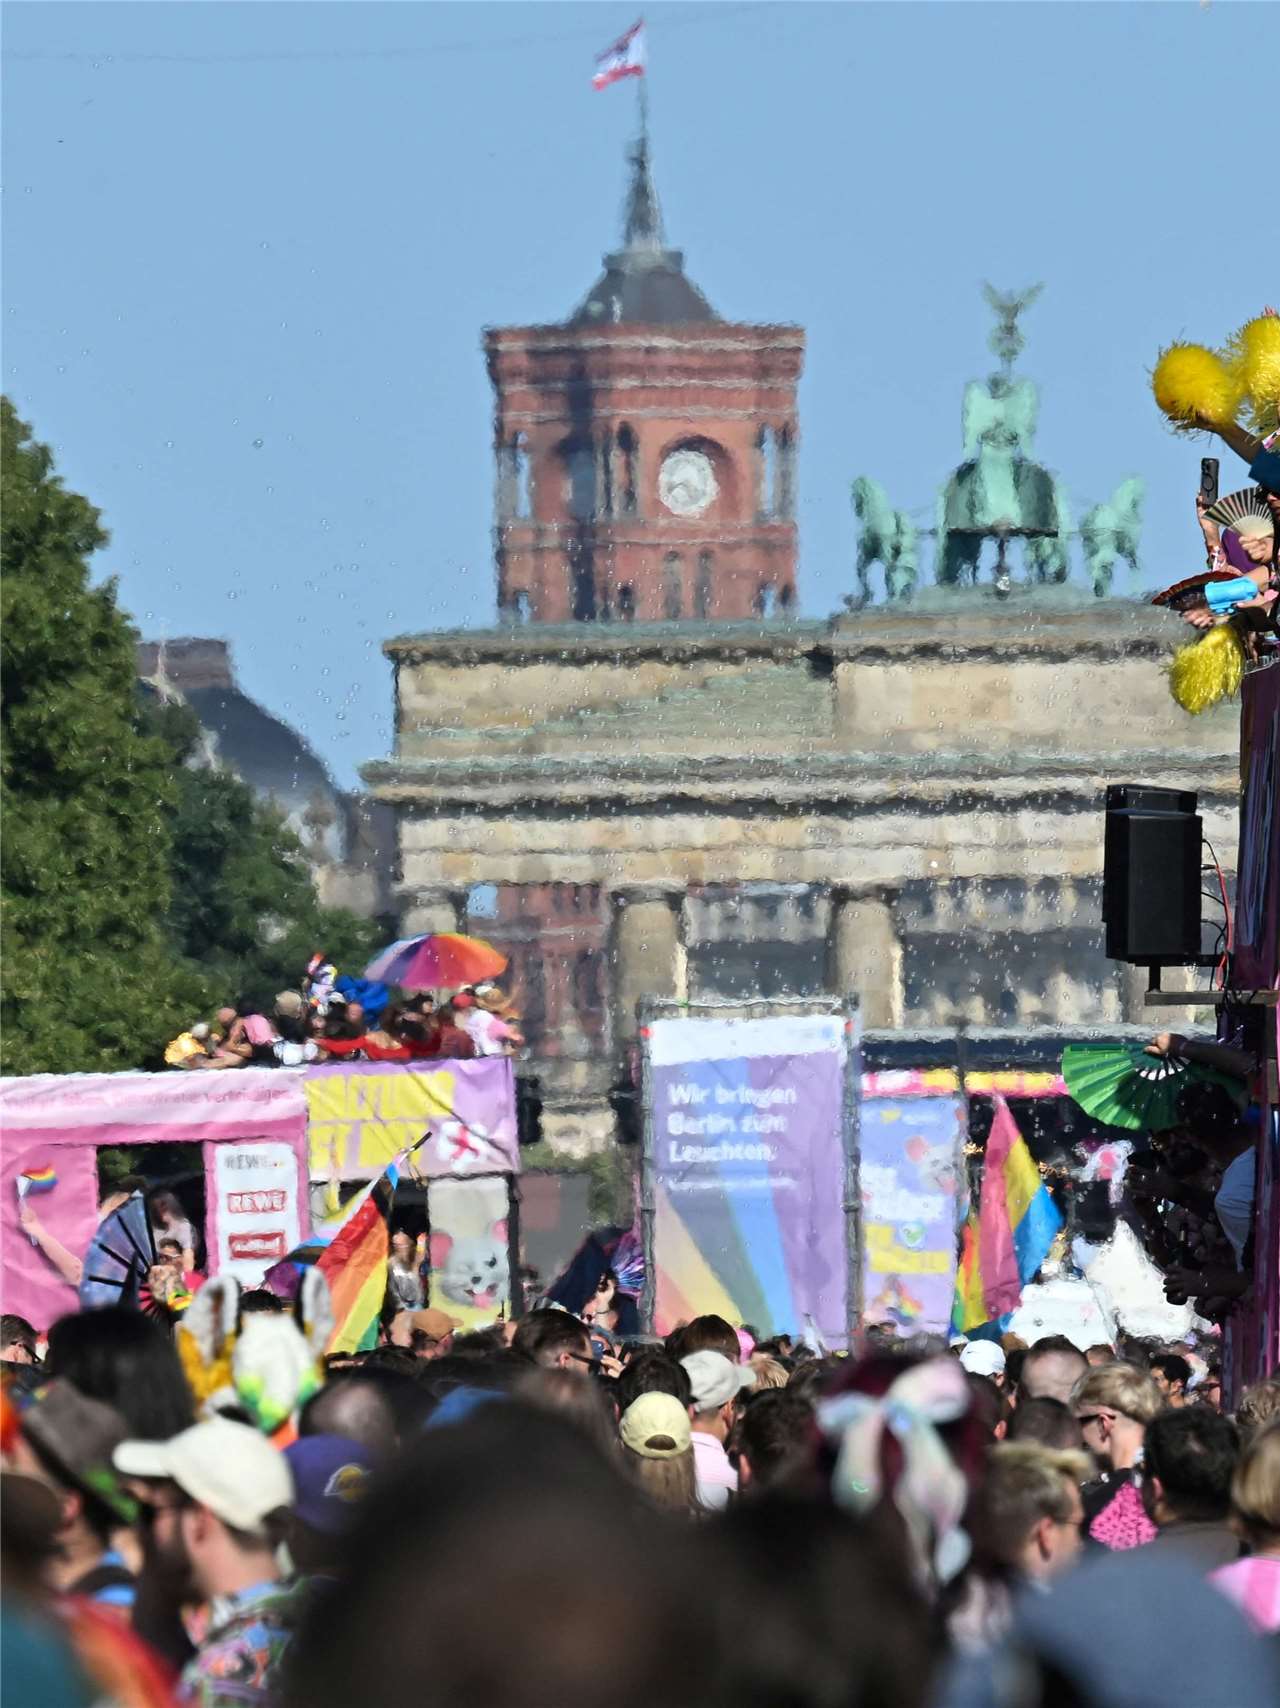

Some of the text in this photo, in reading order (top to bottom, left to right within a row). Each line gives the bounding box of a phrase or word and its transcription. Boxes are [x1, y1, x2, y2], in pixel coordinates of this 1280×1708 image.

[668, 1083, 797, 1108] Wir bringen
[667, 1111, 736, 1135] Berlin
